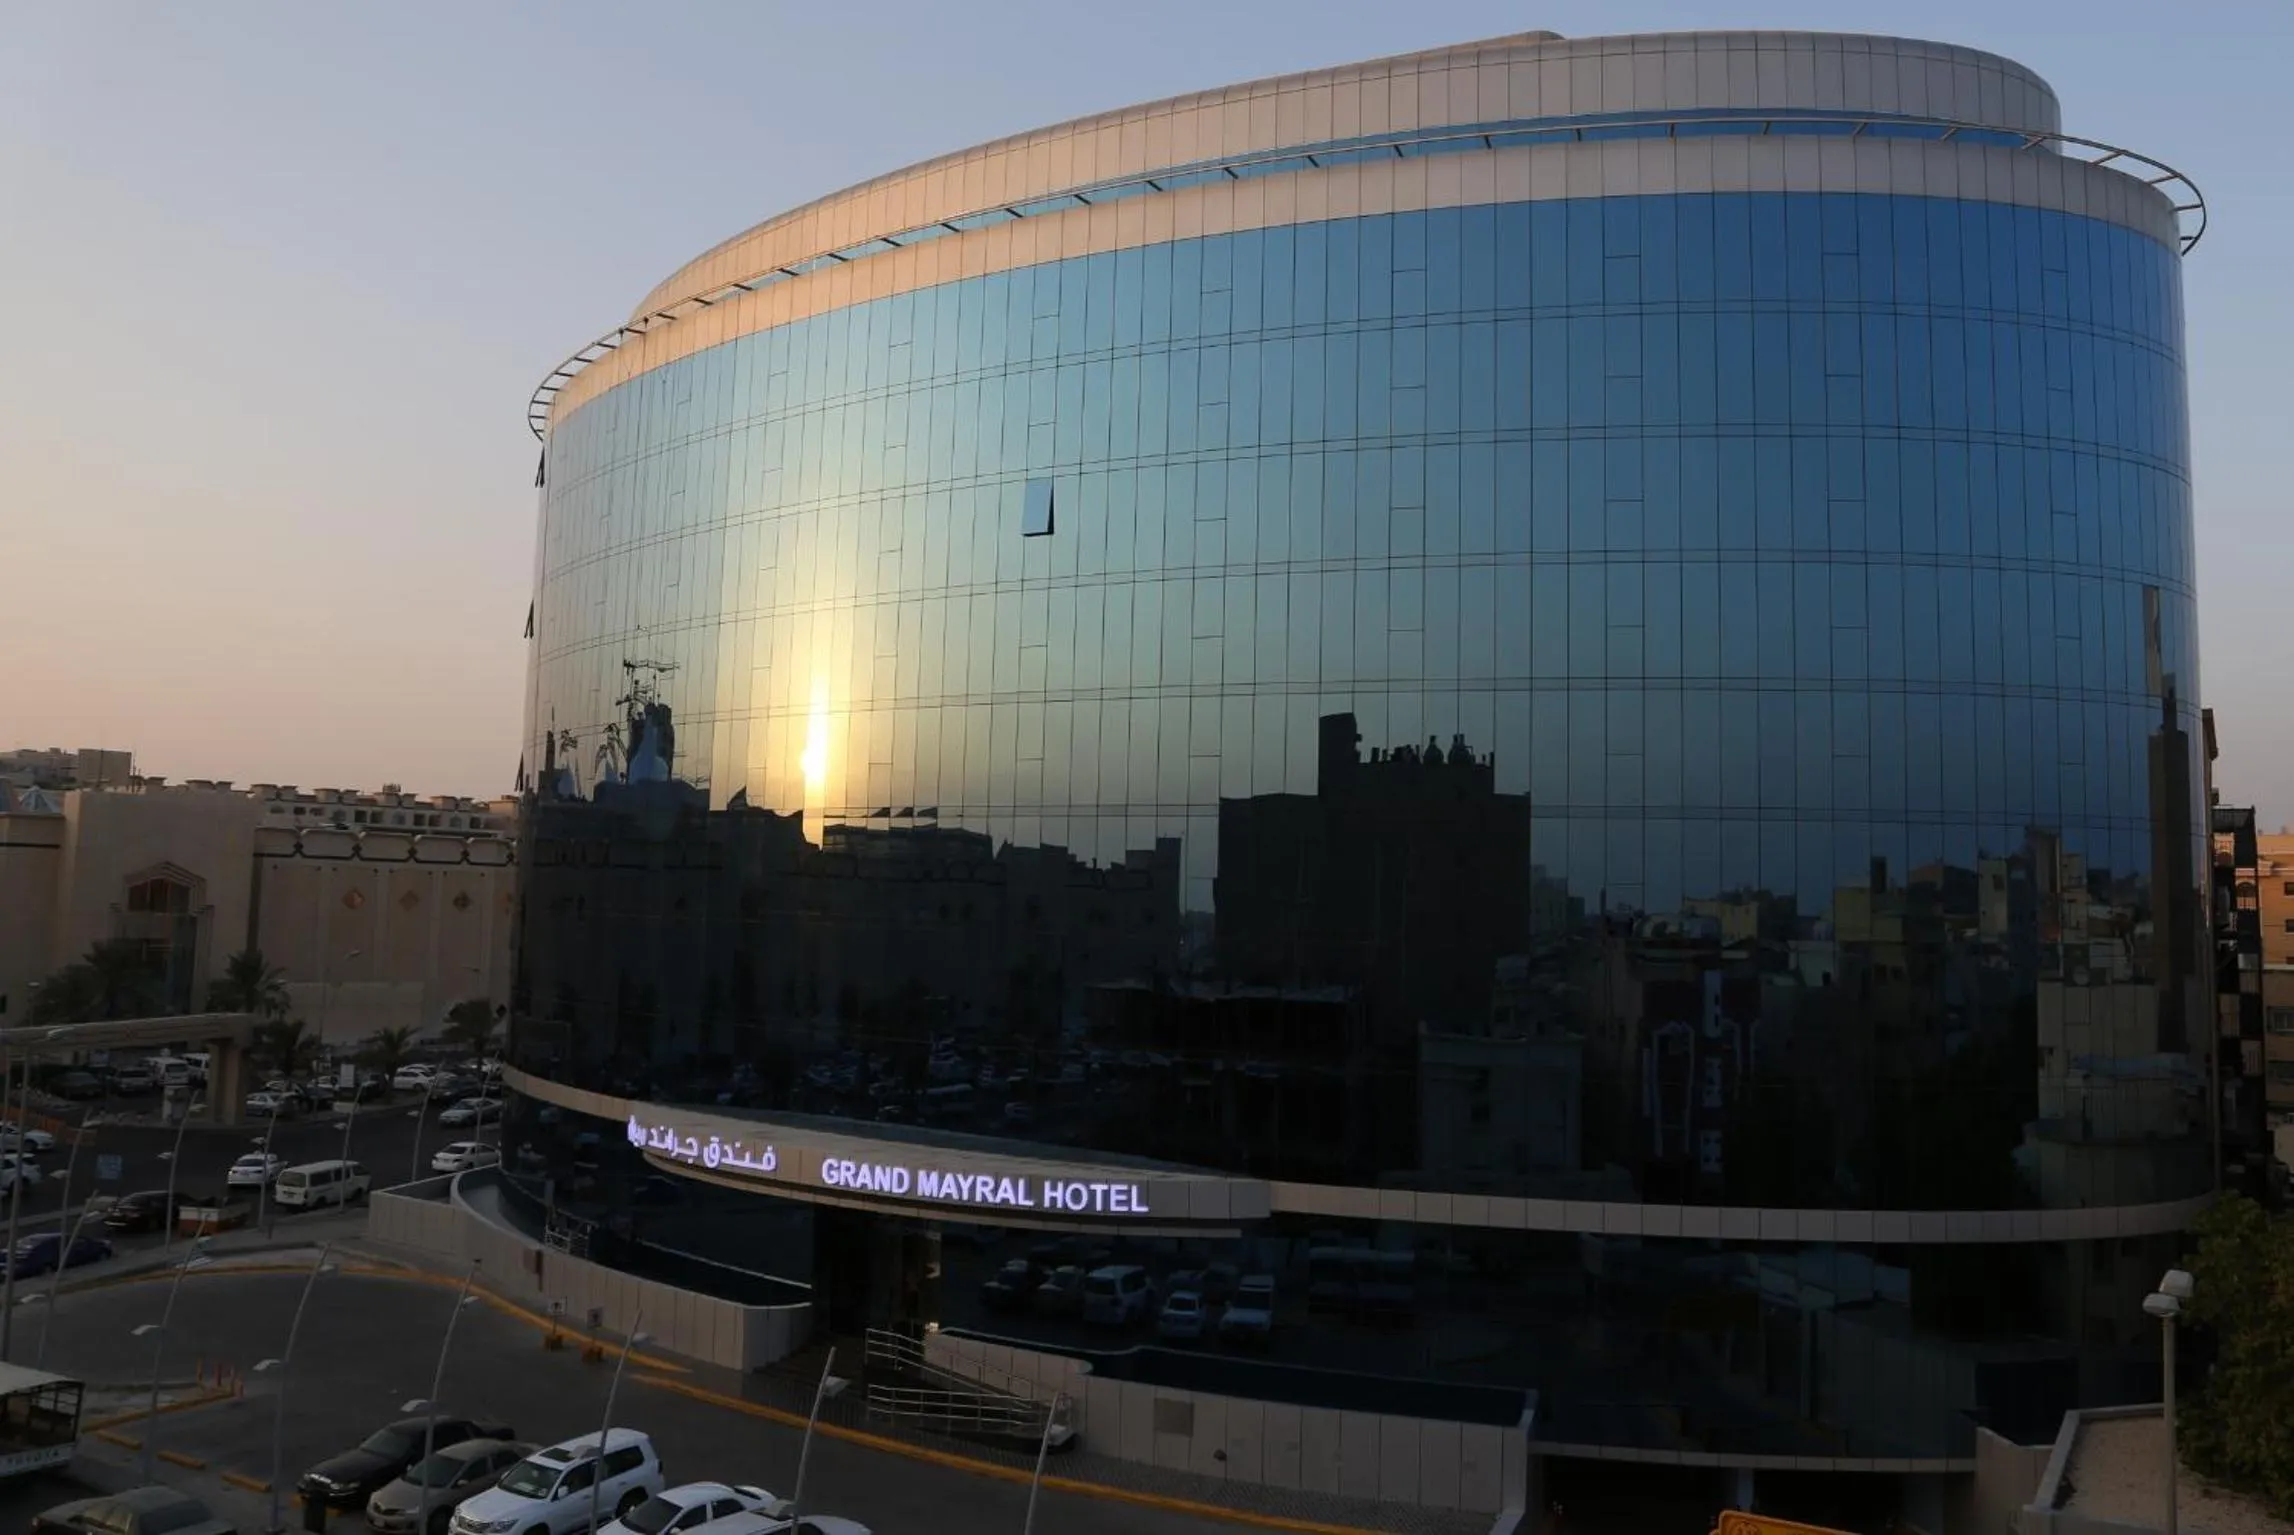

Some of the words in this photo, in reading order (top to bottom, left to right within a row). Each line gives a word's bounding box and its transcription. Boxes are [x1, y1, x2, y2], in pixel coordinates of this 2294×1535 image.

[702, 1135, 777, 1172] فندق
[821, 1157, 910, 1194] GRAND
[917, 1168, 1035, 1207] MAYRAL
[1043, 1180, 1149, 1213] HOTEL
